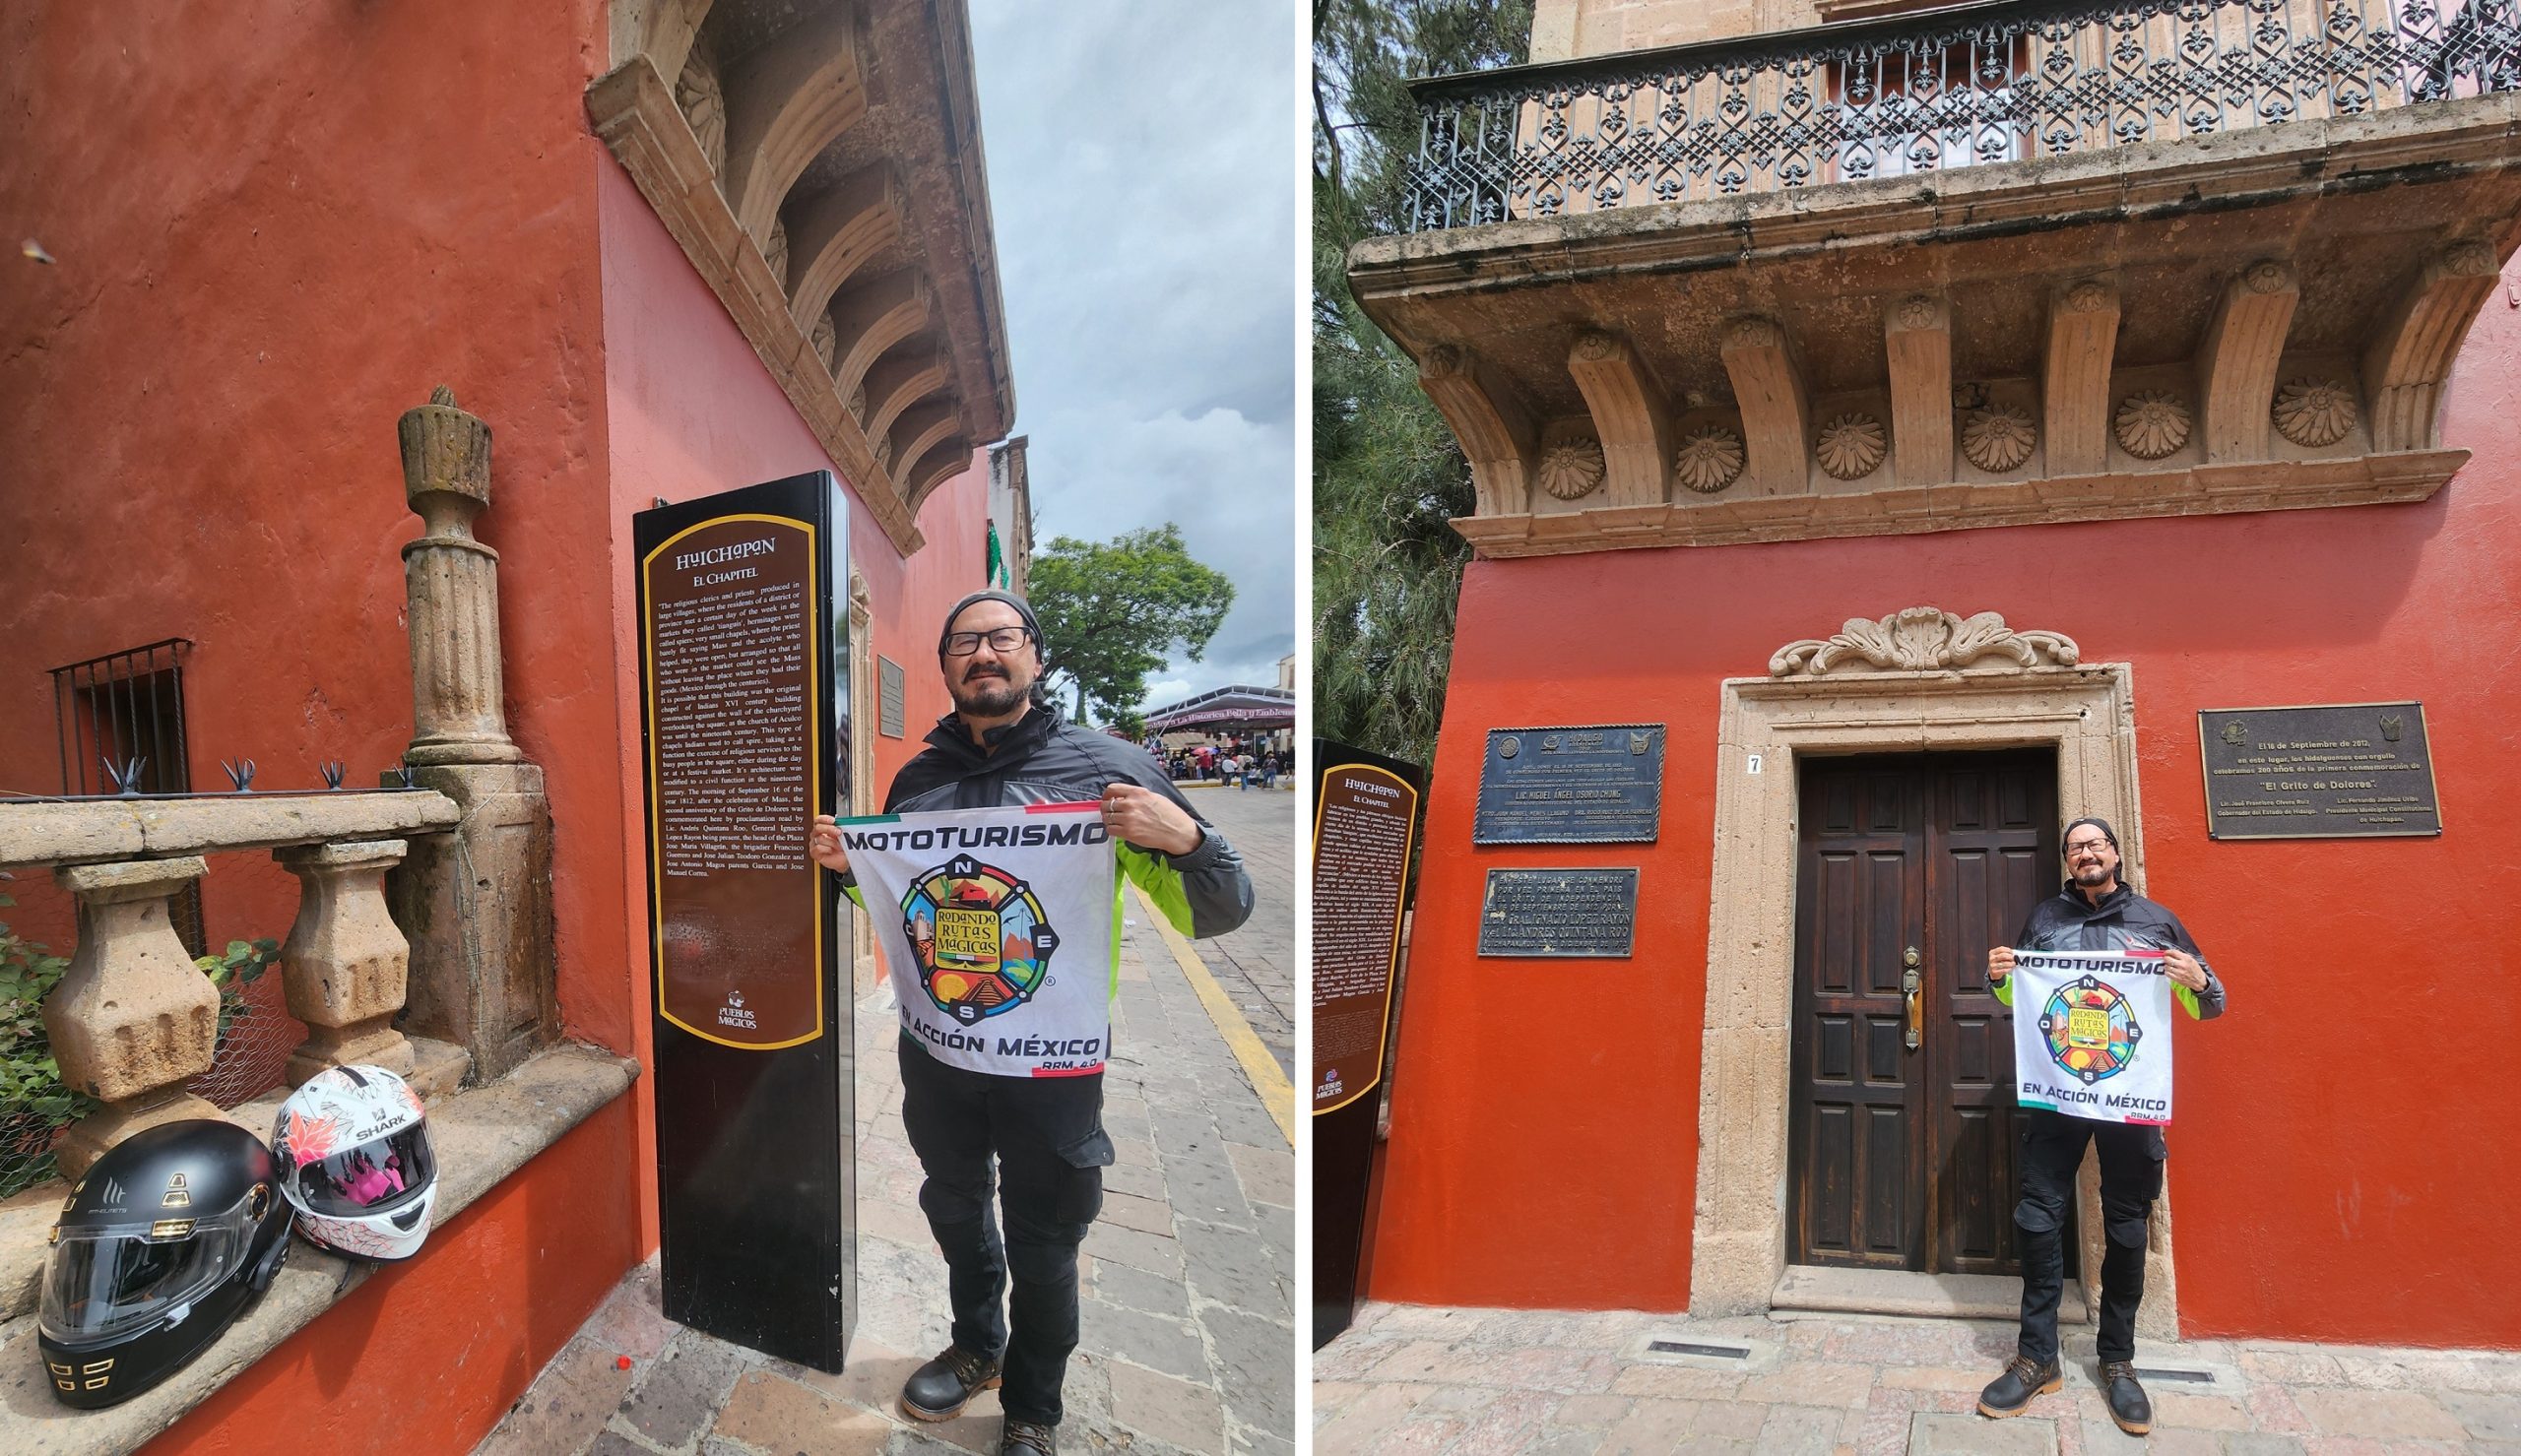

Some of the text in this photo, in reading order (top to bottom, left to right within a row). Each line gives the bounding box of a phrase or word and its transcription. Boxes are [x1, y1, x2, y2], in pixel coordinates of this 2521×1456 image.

[693, 567, 758, 588] EL CHAPITEL
[2291, 740, 2338, 751] Septiembre
[1751, 757, 1759, 772] 7
[2281, 782, 2308, 791] Grito
[1353, 794, 1390, 808] EL CHAPITEL
[842, 822, 1109, 852] MOTOTURISMO
[955, 861, 972, 873] N
[1037, 935, 1052, 948] E
[2083, 979, 2095, 987] N
[959, 1006, 974, 1018] S
[914, 1017, 985, 1053] ACCIÓN
[997, 1034, 1101, 1057] MÉXICO
[1042, 1060, 1073, 1071] RRM
[2084, 1072, 2094, 1081] S
[2023, 1083, 2166, 1111] EN ACCIÓN MÉXICO
[356, 1113, 407, 1141] SHARK
